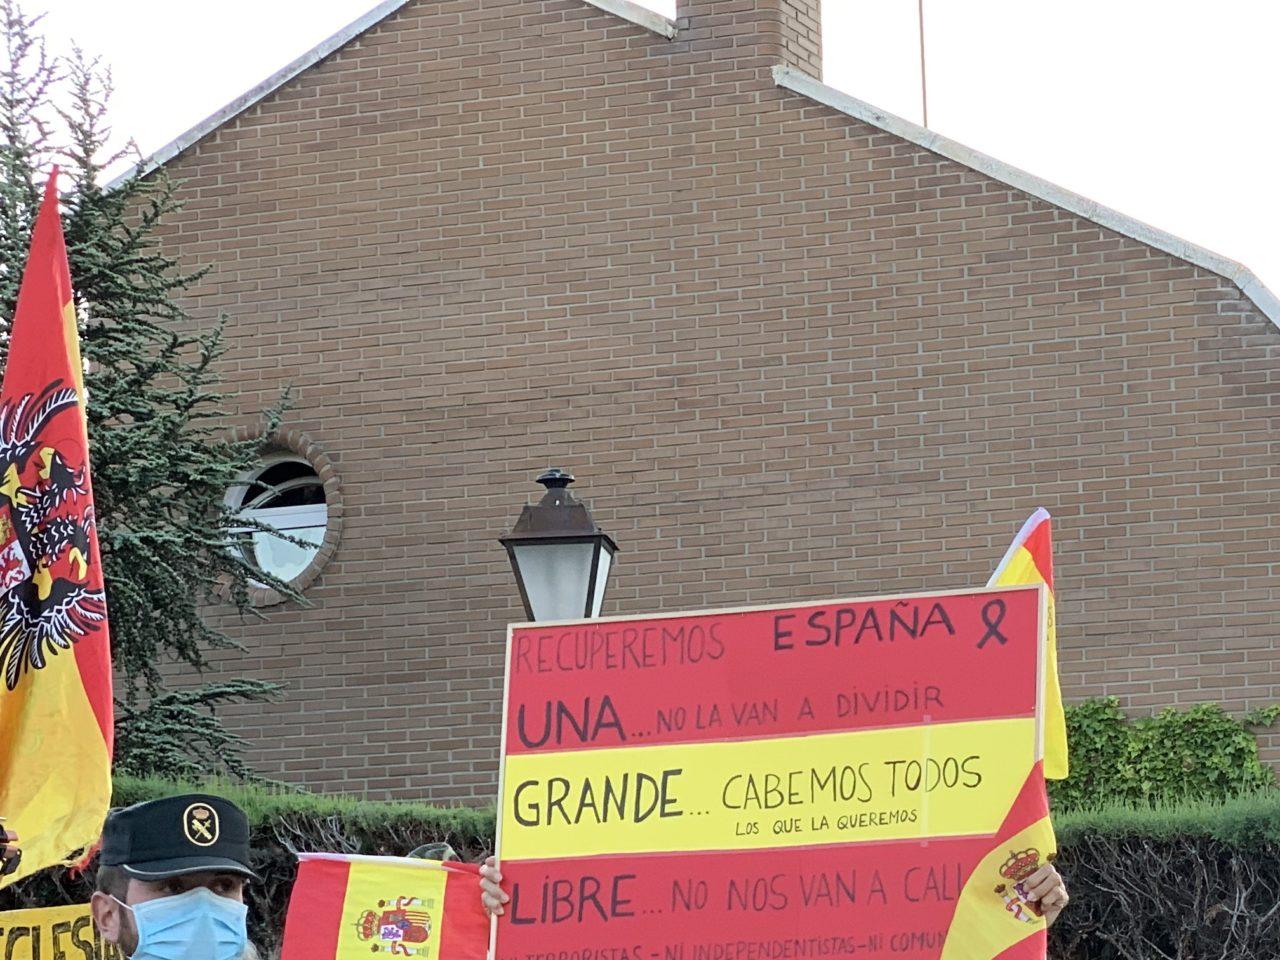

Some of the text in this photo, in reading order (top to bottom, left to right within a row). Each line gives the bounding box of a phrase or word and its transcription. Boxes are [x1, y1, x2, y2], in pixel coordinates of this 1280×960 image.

[515, 601, 956, 674] RECUPEREMOS ESPAÑA
[656, 707, 686, 734] NO
[695, 704, 722, 729] LA
[731, 698, 778, 724] VAN
[799, 697, 815, 720] A
[837, 681, 944, 717] DIVIDIR
[722, 762, 873, 810] CABEMOS
[884, 755, 982, 797] TODOS
[735, 809, 918, 836] LOS QUE LA QUEREMOS
[671, 879, 708, 913] NO
[727, 873, 788, 912] NOS
[799, 869, 856, 908] VAN
[869, 869, 887, 906] A
